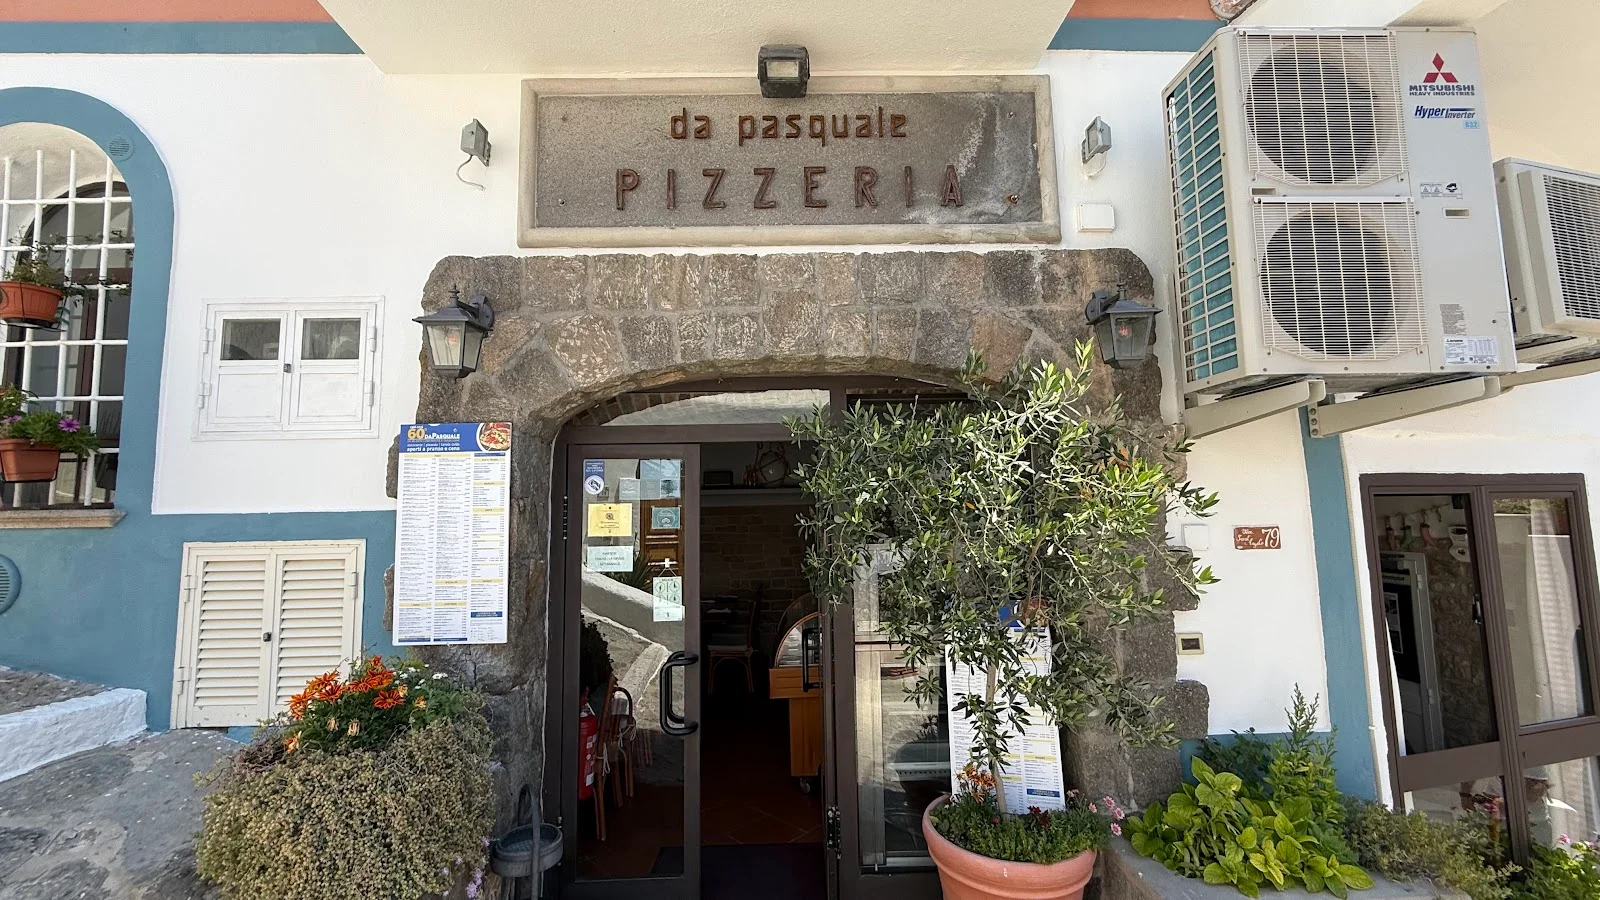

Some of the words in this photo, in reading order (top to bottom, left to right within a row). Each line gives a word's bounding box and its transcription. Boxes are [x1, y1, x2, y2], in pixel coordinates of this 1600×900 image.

[669, 107, 712, 140] da
[737, 106, 908, 148] pasquale
[1414, 105, 1445, 118] Hyper
[1445, 107, 1476, 119] Inverter
[615, 164, 964, 211] PIZZERIA
[1261, 528, 1280, 548] 79
